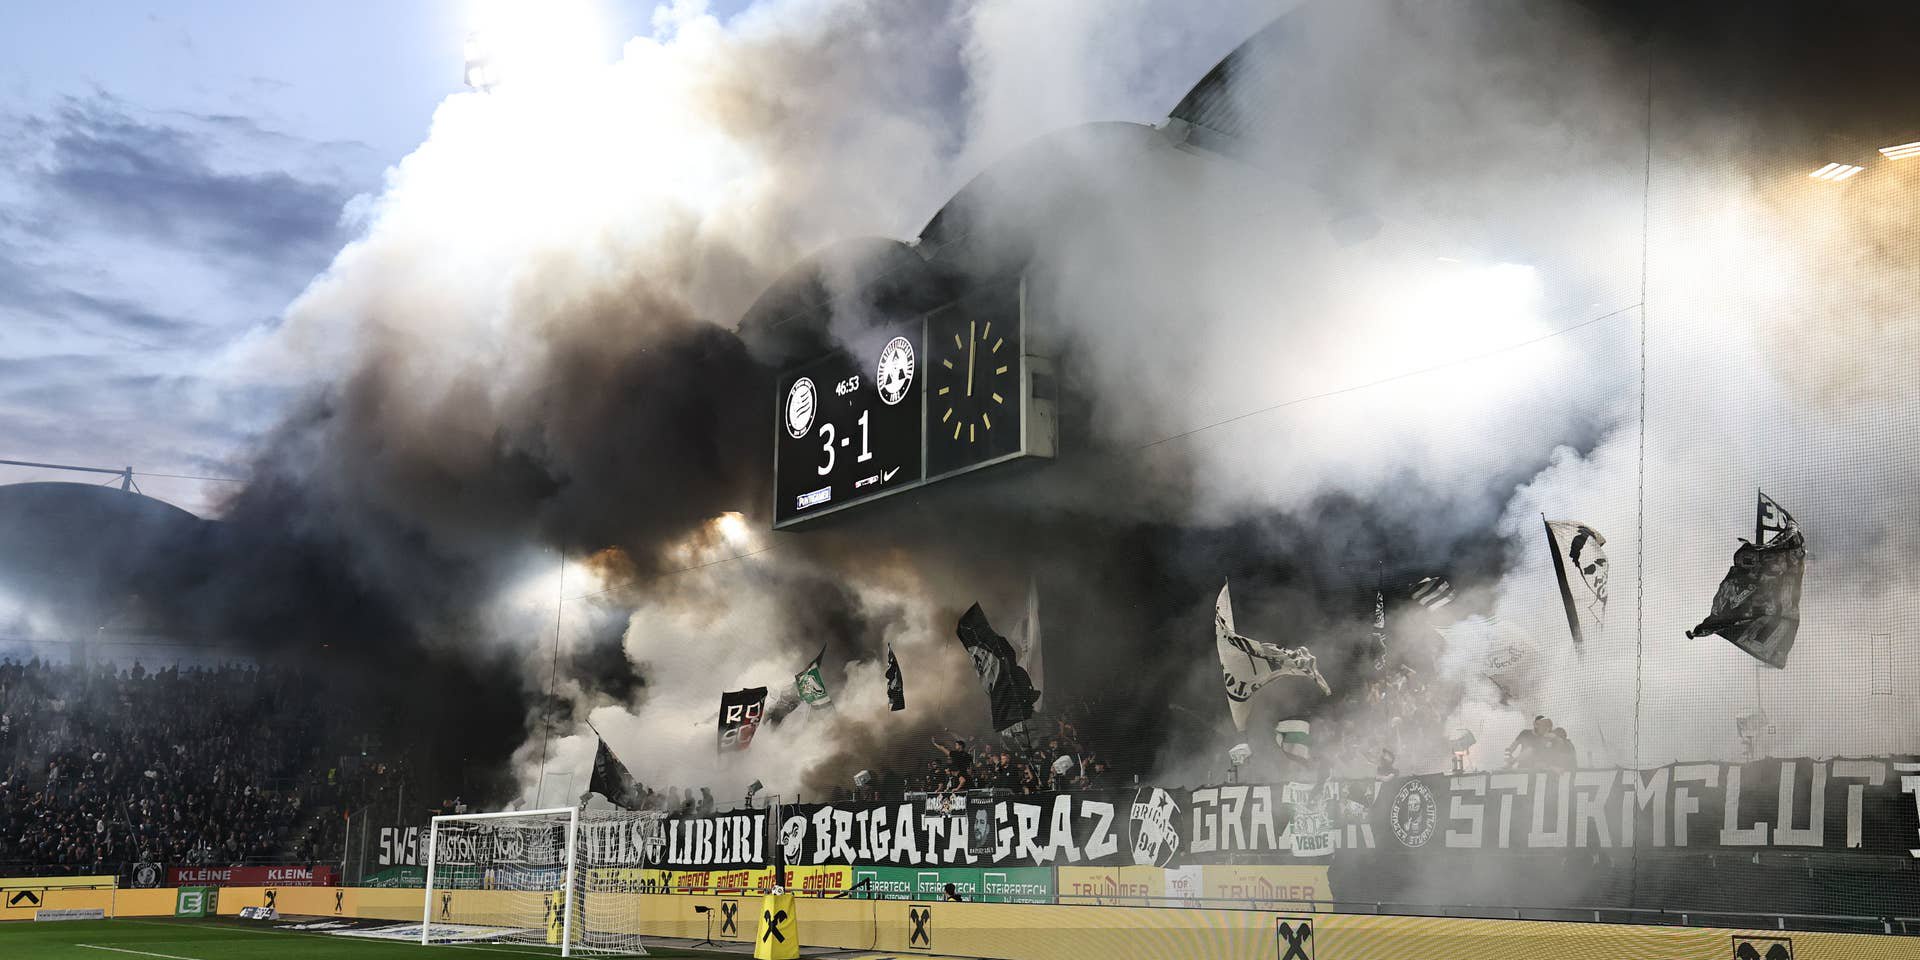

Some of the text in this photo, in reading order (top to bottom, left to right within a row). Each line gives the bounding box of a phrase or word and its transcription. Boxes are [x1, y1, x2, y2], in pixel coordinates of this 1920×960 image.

[836, 375, 860, 396] 46:53
[1190, 782, 1382, 854] GRAR
[1445, 760, 1886, 848] STURMFLUT
[667, 815, 766, 864] LIBERI
[812, 795, 1118, 866] BRIGATA GRAZ
[379, 827, 418, 865] SWS
[560, 820, 645, 863] JWELS
[1139, 832, 1157, 859] 94
[1296, 833, 1329, 851] VERDE
[178, 870, 232, 881] KLEINE
[268, 869, 313, 880] KLEINE
[677, 872, 710, 888] antenne
[717, 871, 749, 889] antenne
[757, 871, 794, 888] antee
[803, 871, 843, 890] antenne
